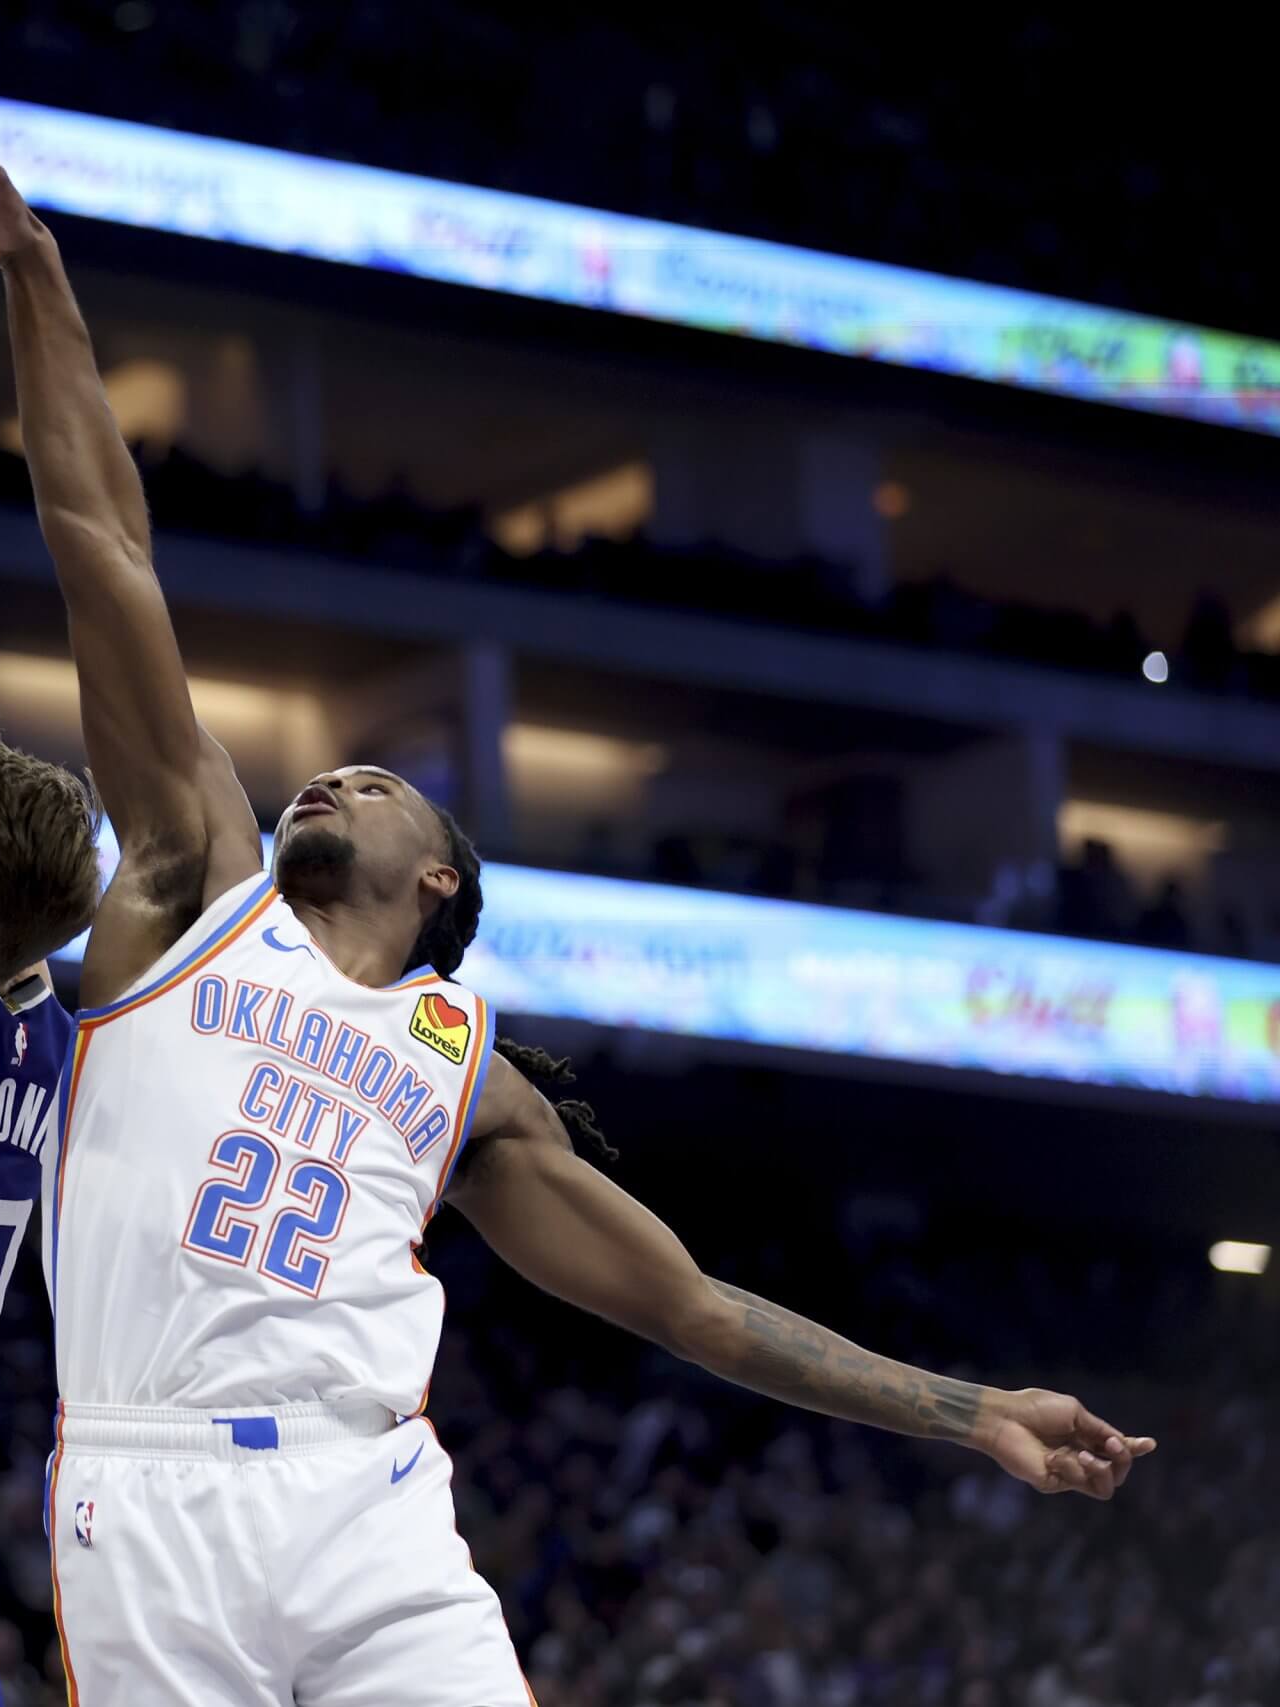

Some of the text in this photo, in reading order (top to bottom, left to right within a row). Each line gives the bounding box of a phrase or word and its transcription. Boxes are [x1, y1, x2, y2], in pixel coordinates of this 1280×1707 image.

[192, 974, 450, 1165] OKLAHOMA
[239, 1062, 371, 1168] CITY
[181, 1129, 351, 1299] 22
